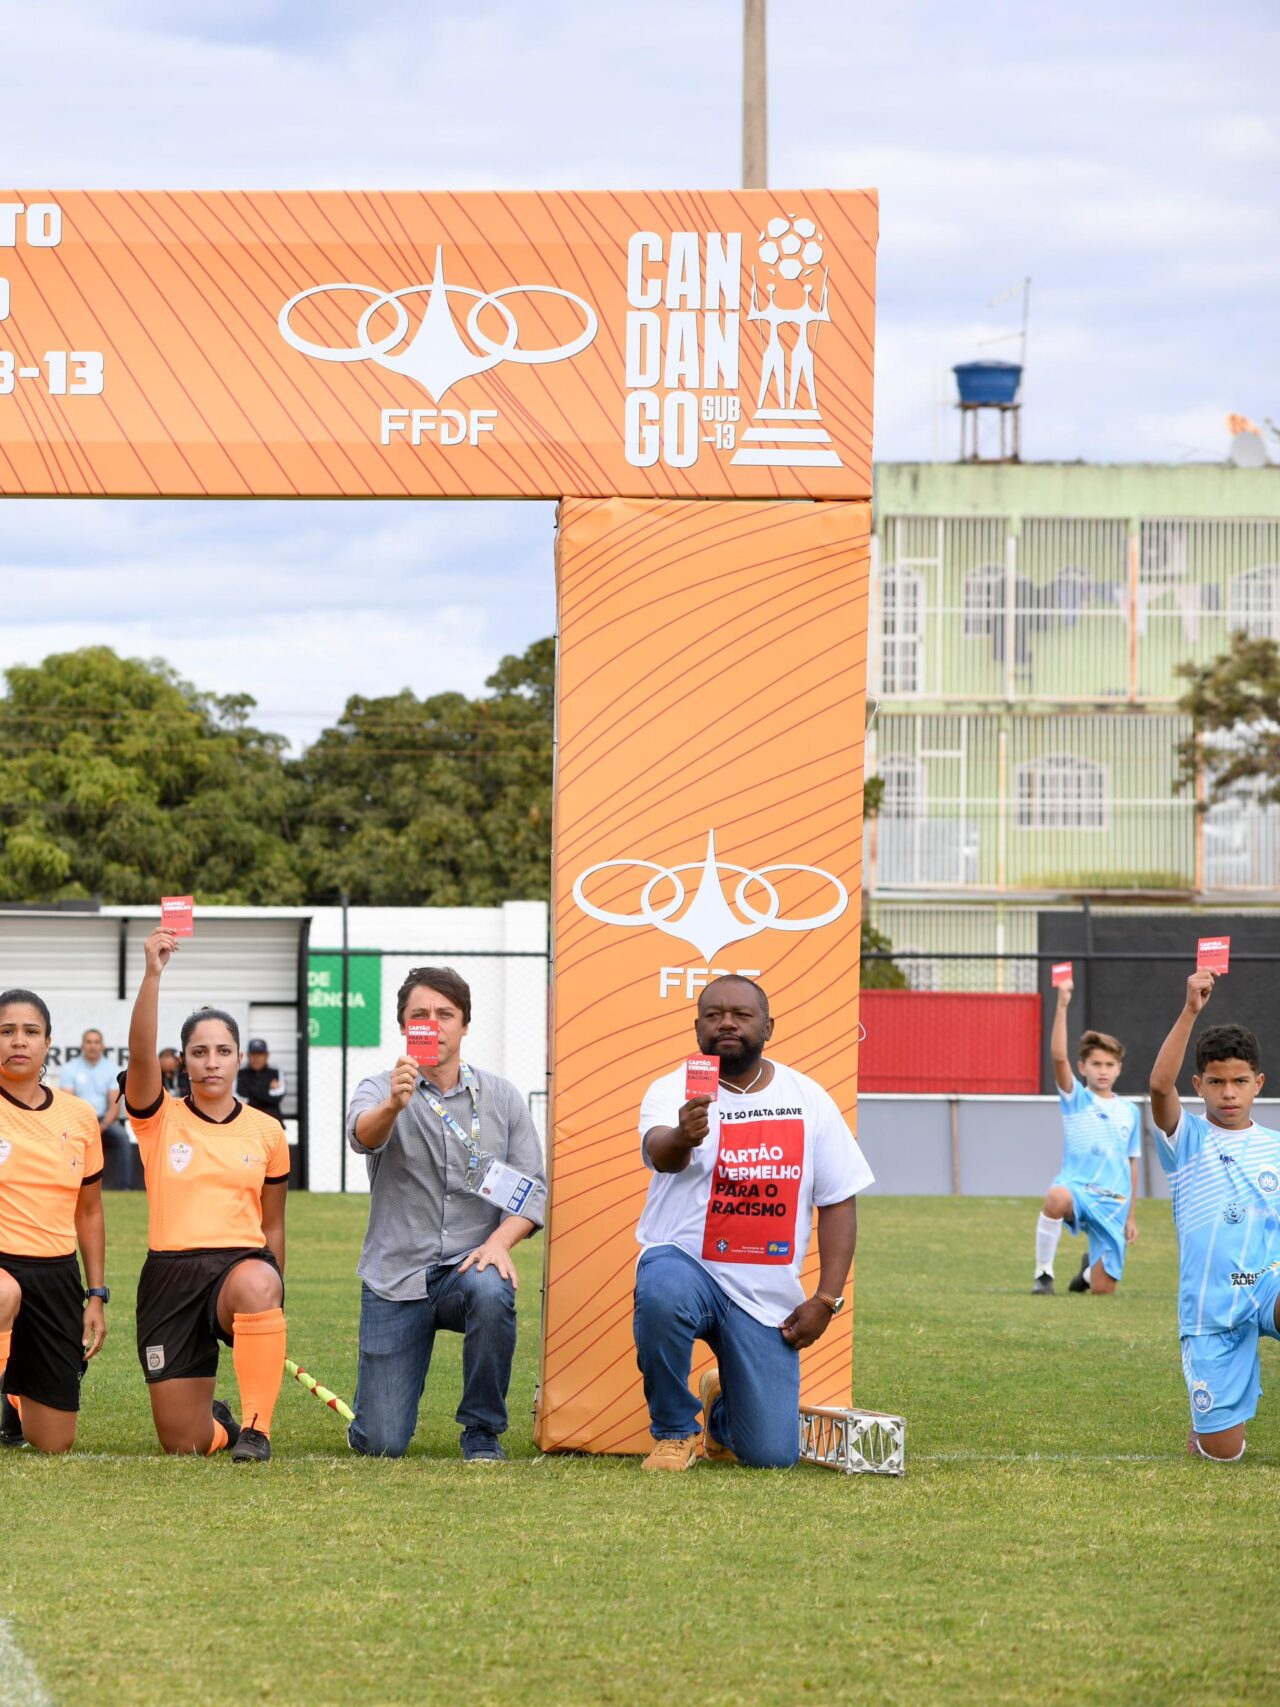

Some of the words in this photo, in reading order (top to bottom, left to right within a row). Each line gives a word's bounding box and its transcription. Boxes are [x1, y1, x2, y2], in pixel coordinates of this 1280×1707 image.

[626, 231, 742, 310] CAN
[624, 311, 740, 390] DAN
[701, 395, 741, 424] SUB
[380, 409, 498, 446] FFDF
[623, 390, 700, 468] GO
[701, 423, 736, 450] -13
[660, 966, 761, 999] FF
[748, 1108, 774, 1118] FALTA
[775, 1107, 803, 1116] GRAVE
[720, 1142, 783, 1164] CARTÃO
[718, 1164, 801, 1181] VERMELHO
[715, 1182, 760, 1198] PARA
[765, 1183, 778, 1198] O
[711, 1199, 787, 1217] RACISMO
